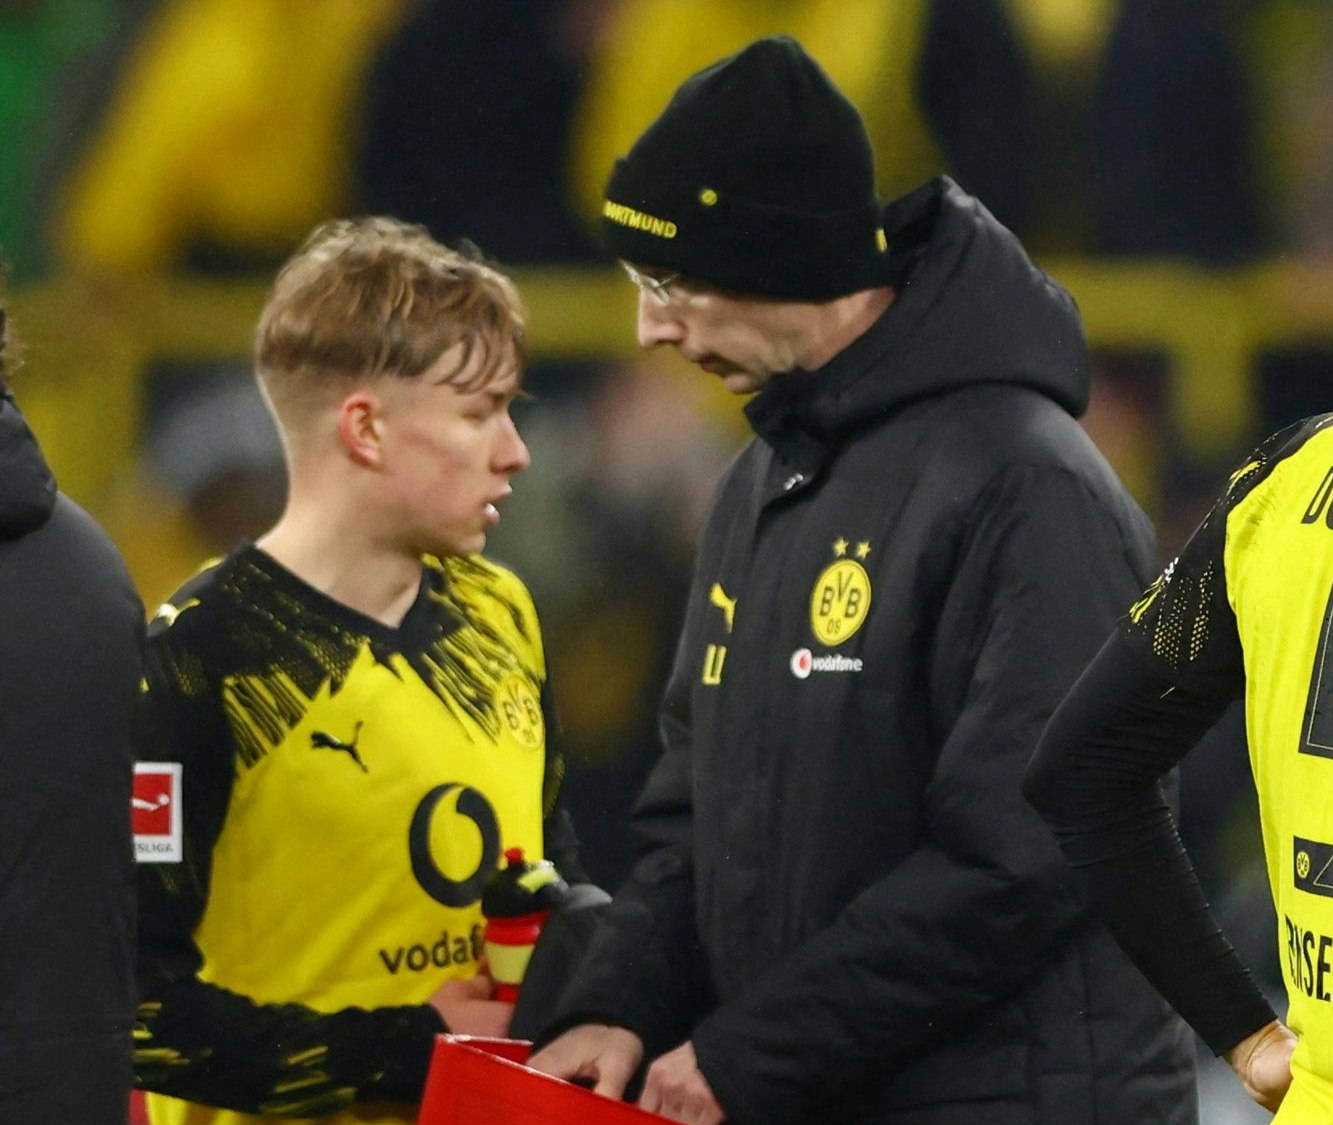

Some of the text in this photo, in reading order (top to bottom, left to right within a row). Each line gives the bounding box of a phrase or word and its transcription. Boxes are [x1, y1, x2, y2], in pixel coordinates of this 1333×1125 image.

[819, 571, 862, 618] BVB
[812, 654, 863, 671] vodafone
[379, 924, 483, 975] vodaf
